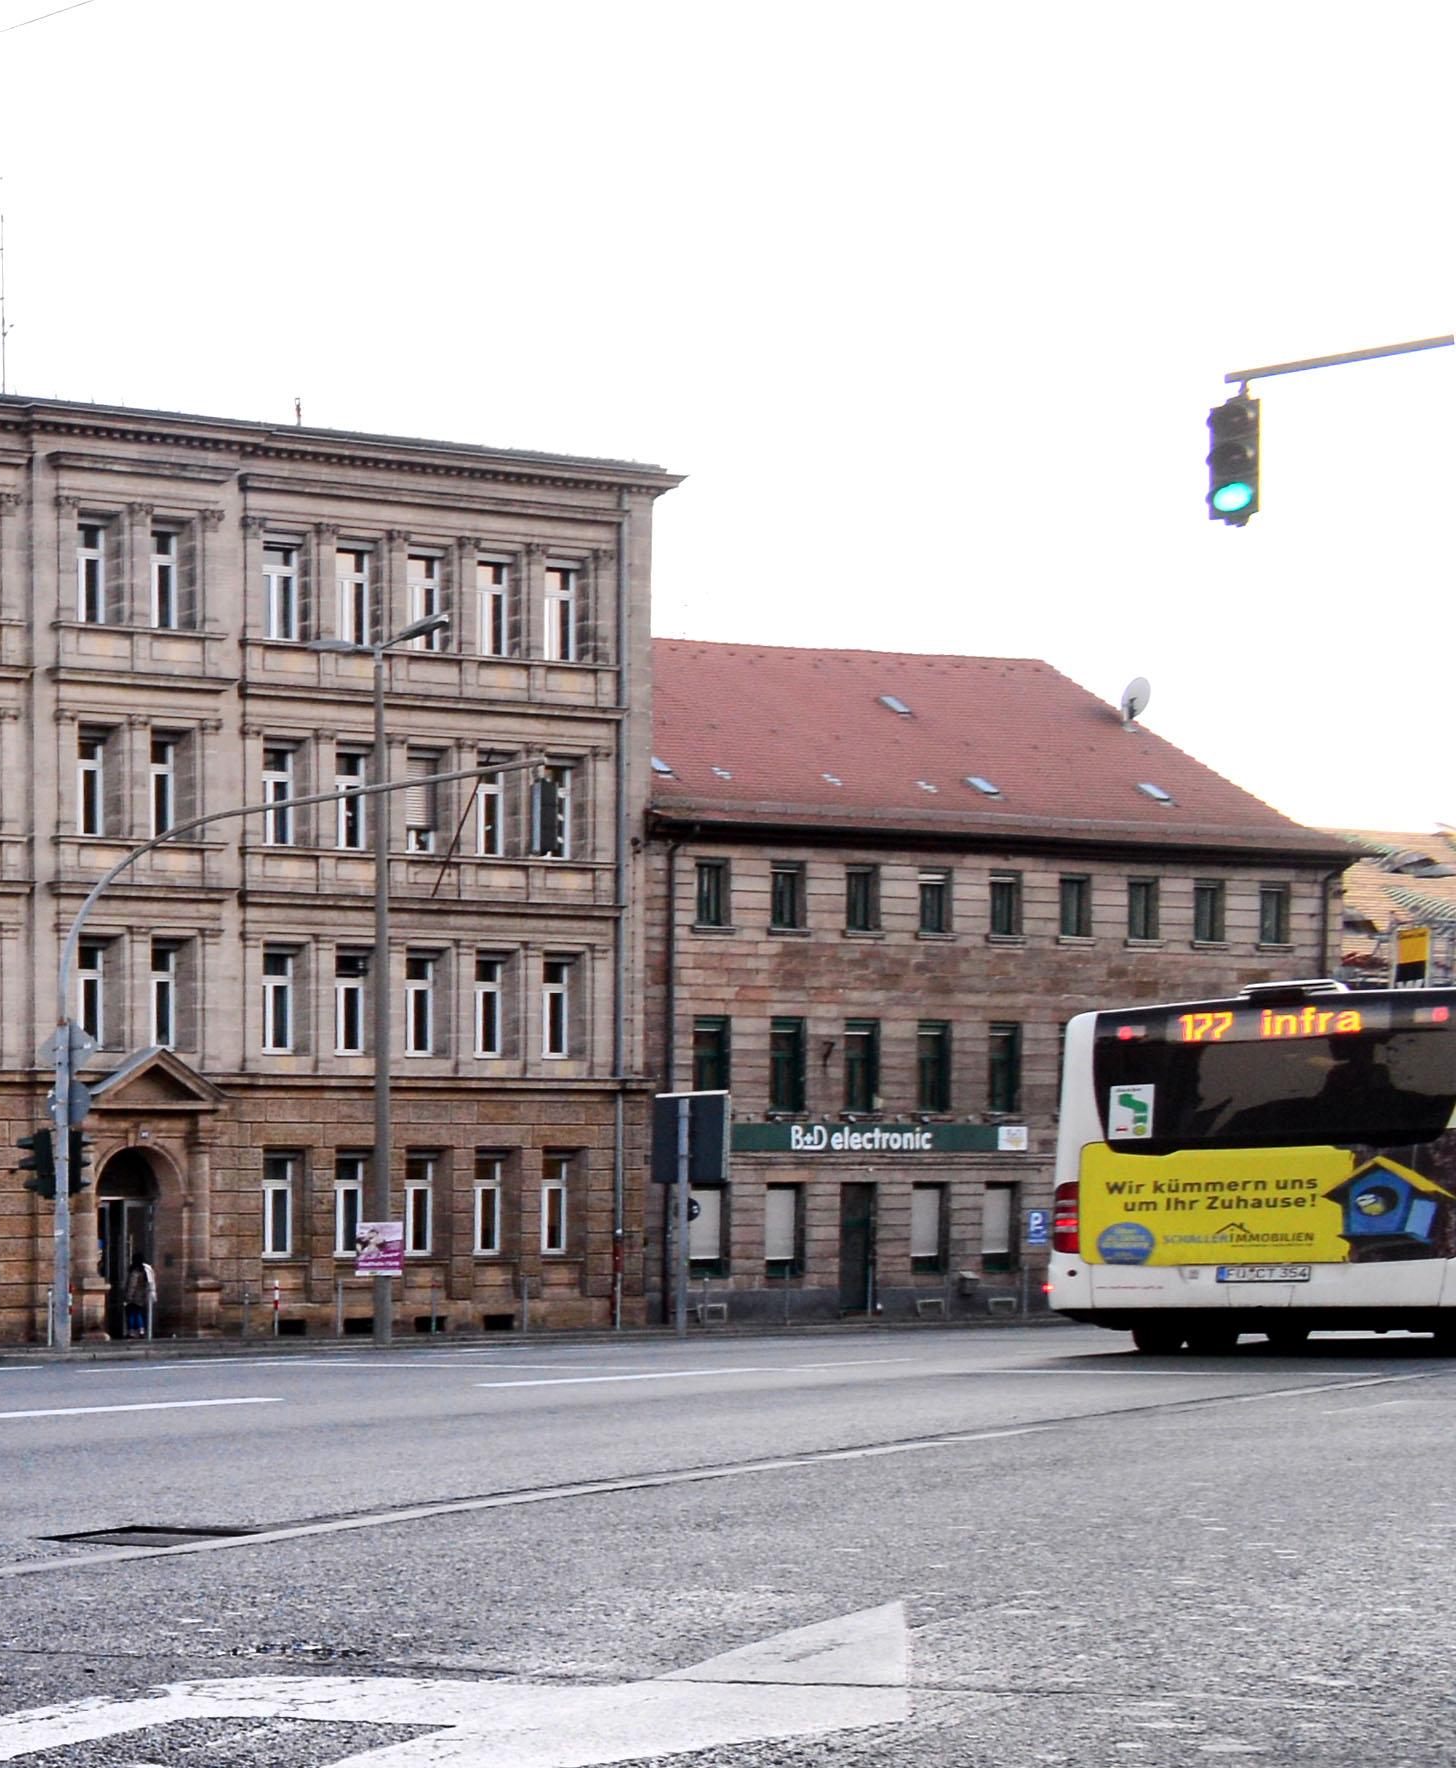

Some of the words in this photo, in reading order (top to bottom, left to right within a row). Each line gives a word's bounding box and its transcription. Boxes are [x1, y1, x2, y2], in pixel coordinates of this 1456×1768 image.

[1179, 1011, 1233, 1042] 177
[1260, 1007, 1361, 1038] infra
[790, 1125, 828, 1150] B+D
[830, 1126, 933, 1150] electronic
[1106, 1181, 1145, 1195] Wir
[1152, 1178, 1268, 1194] kümmern
[1275, 1178, 1319, 1191] uns
[1123, 1200, 1158, 1212] um
[1165, 1197, 1200, 1212] Ihr
[1205, 1194, 1318, 1210] Zuhause!
[1280, 1267, 1308, 1278] 354
